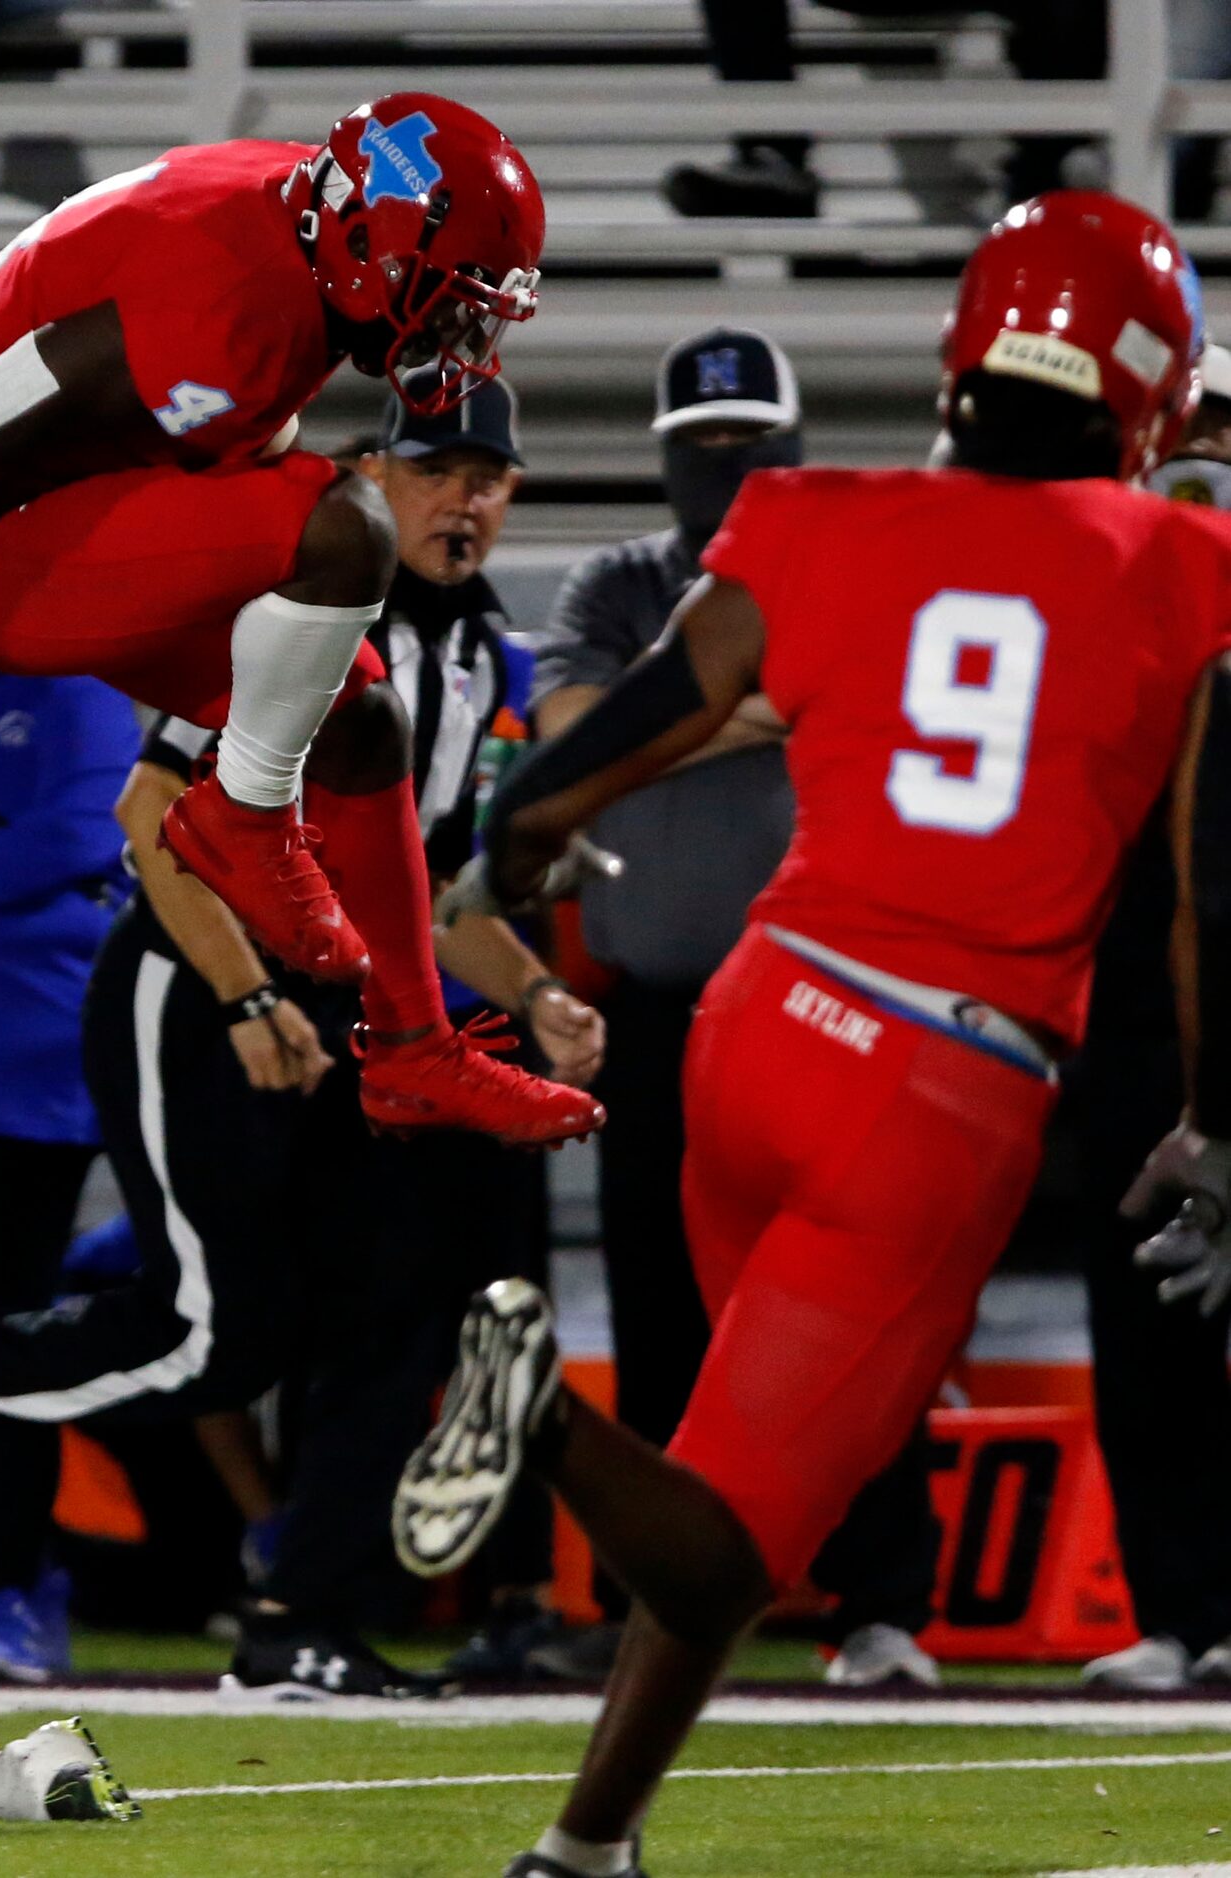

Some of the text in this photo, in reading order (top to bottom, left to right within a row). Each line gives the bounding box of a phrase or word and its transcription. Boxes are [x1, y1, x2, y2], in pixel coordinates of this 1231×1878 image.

[367, 127, 427, 194] RAIDERS
[696, 348, 738, 393] N
[152, 380, 236, 436] 4
[885, 587, 1049, 838] 9
[782, 980, 883, 1055] SKYLINE
